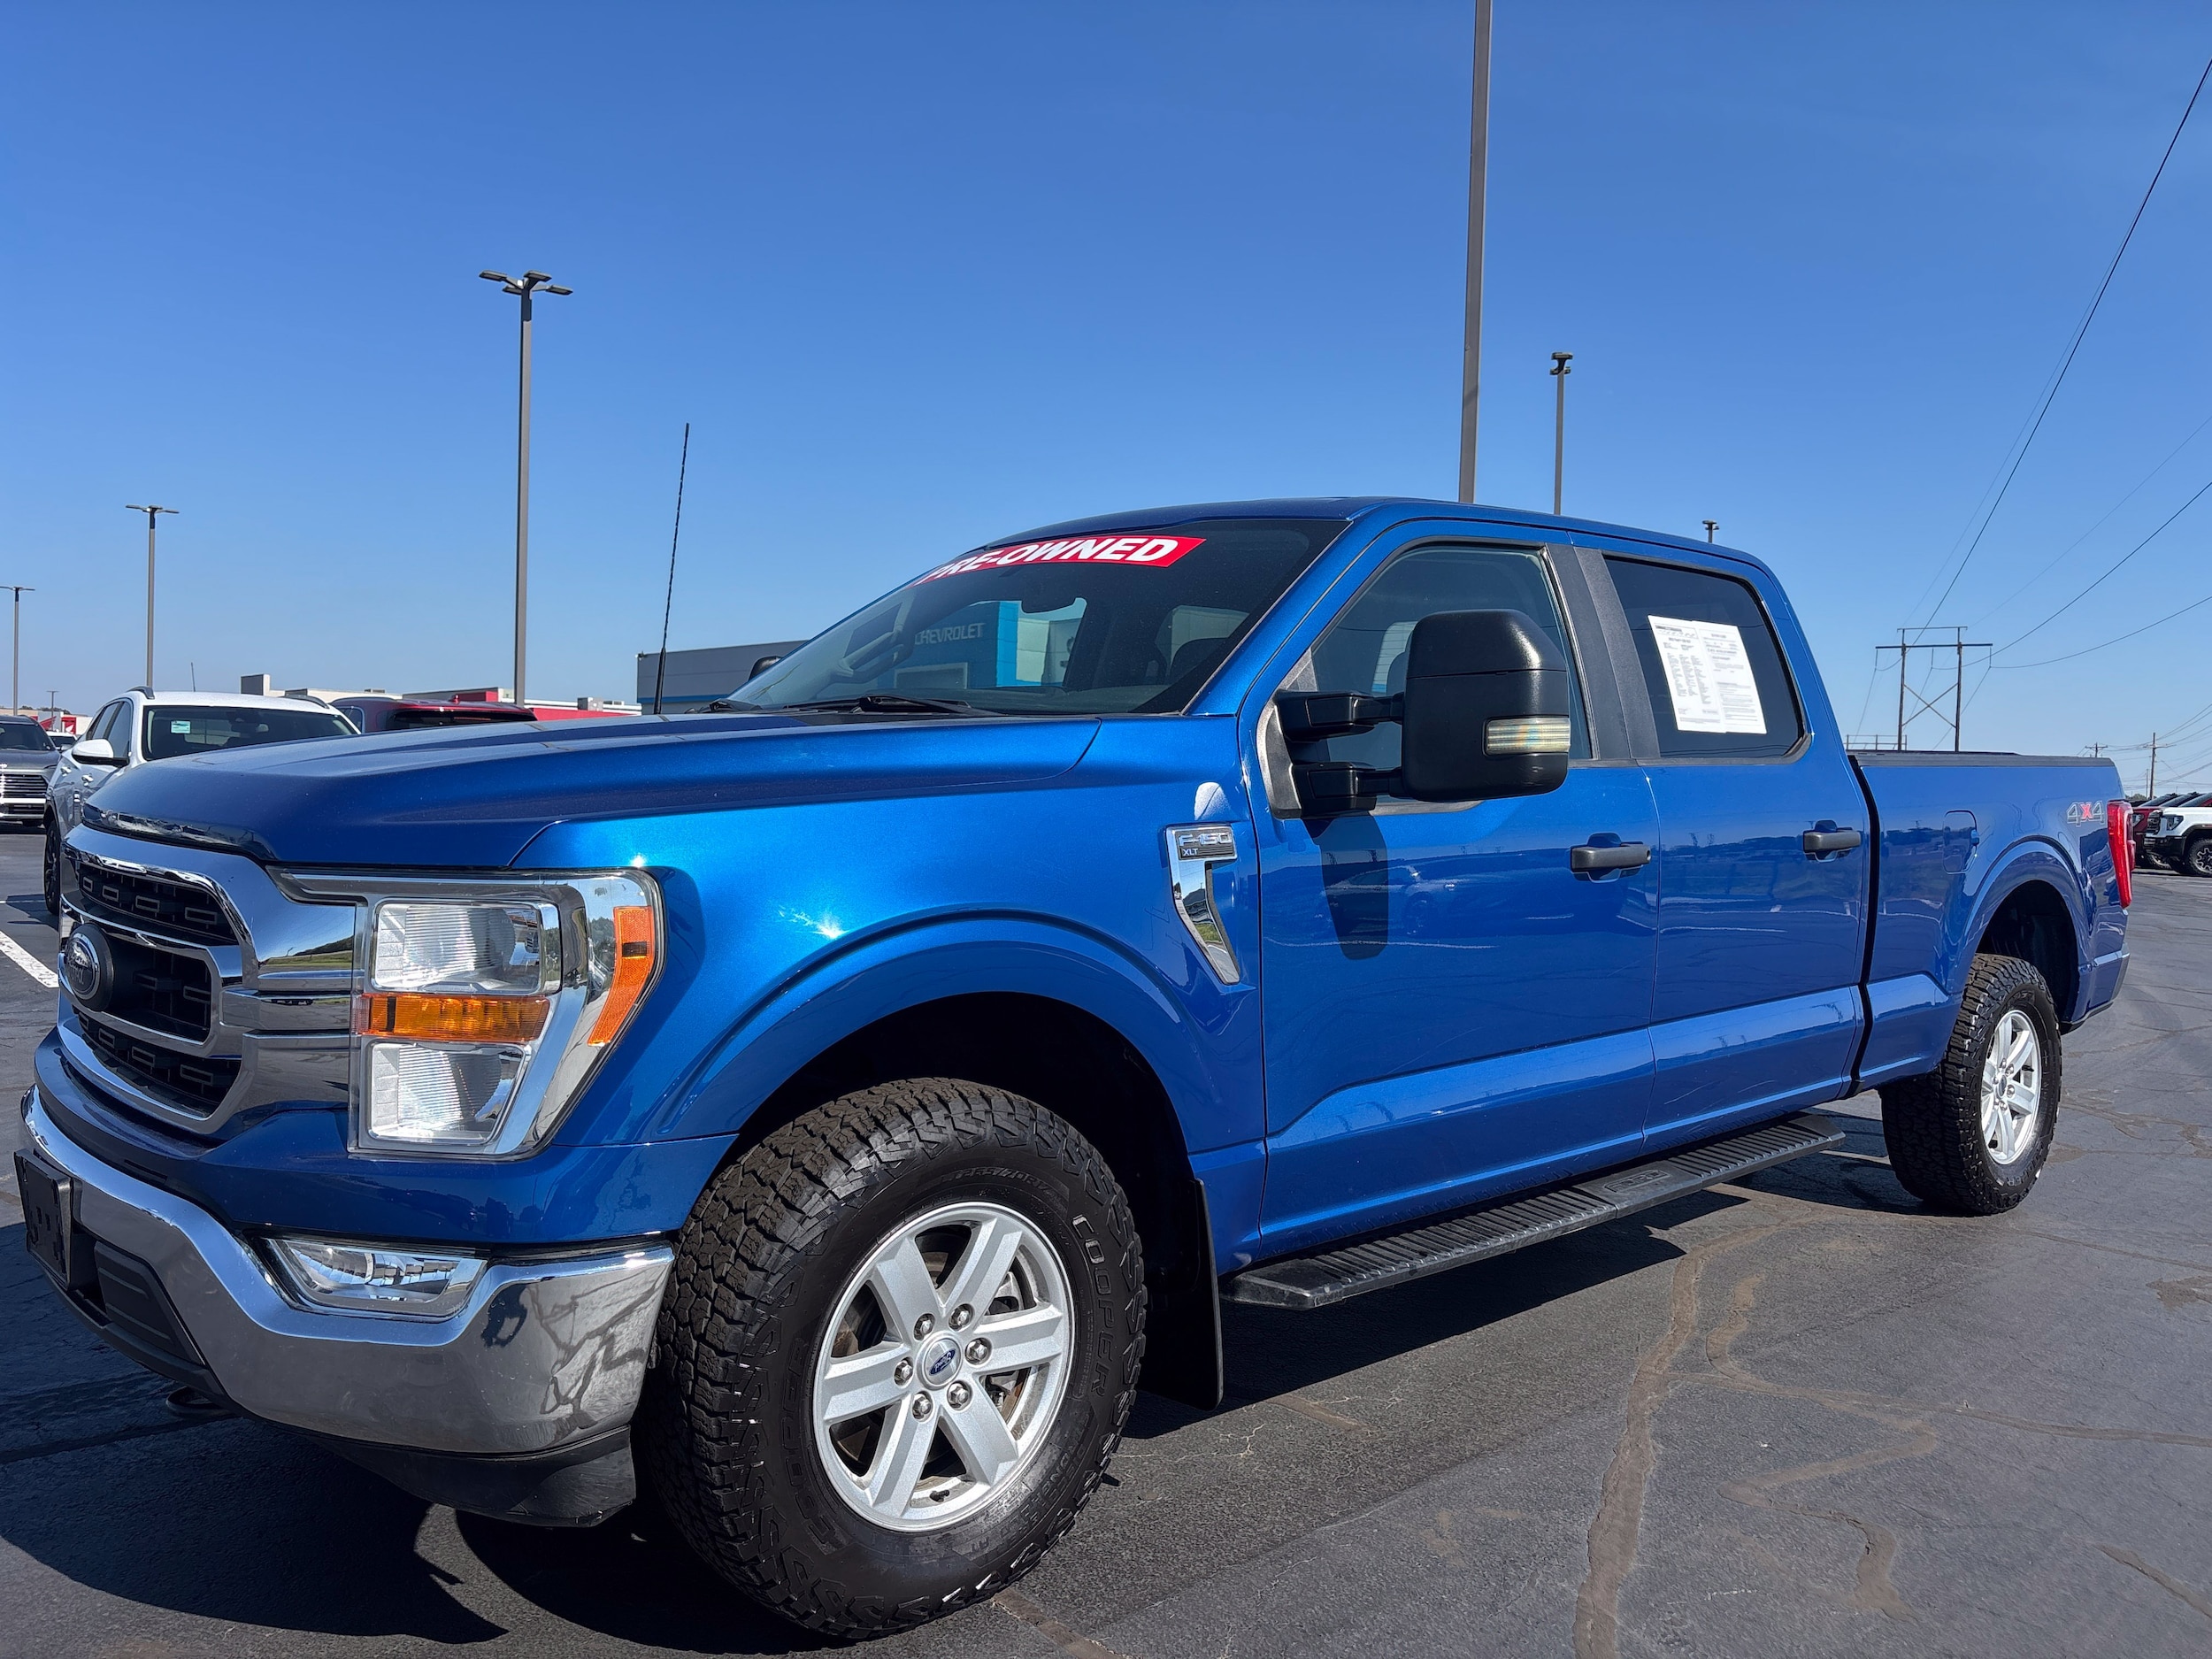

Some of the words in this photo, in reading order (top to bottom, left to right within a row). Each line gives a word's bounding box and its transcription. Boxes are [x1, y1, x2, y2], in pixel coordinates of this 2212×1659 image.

[912, 538, 1179, 586] PRE-OWNED
[915, 623, 985, 645] CHEVROLET
[1179, 832, 1233, 847] F-150
[1182, 848, 1199, 856] XLT
[1072, 1214, 1115, 1397] COOPER
